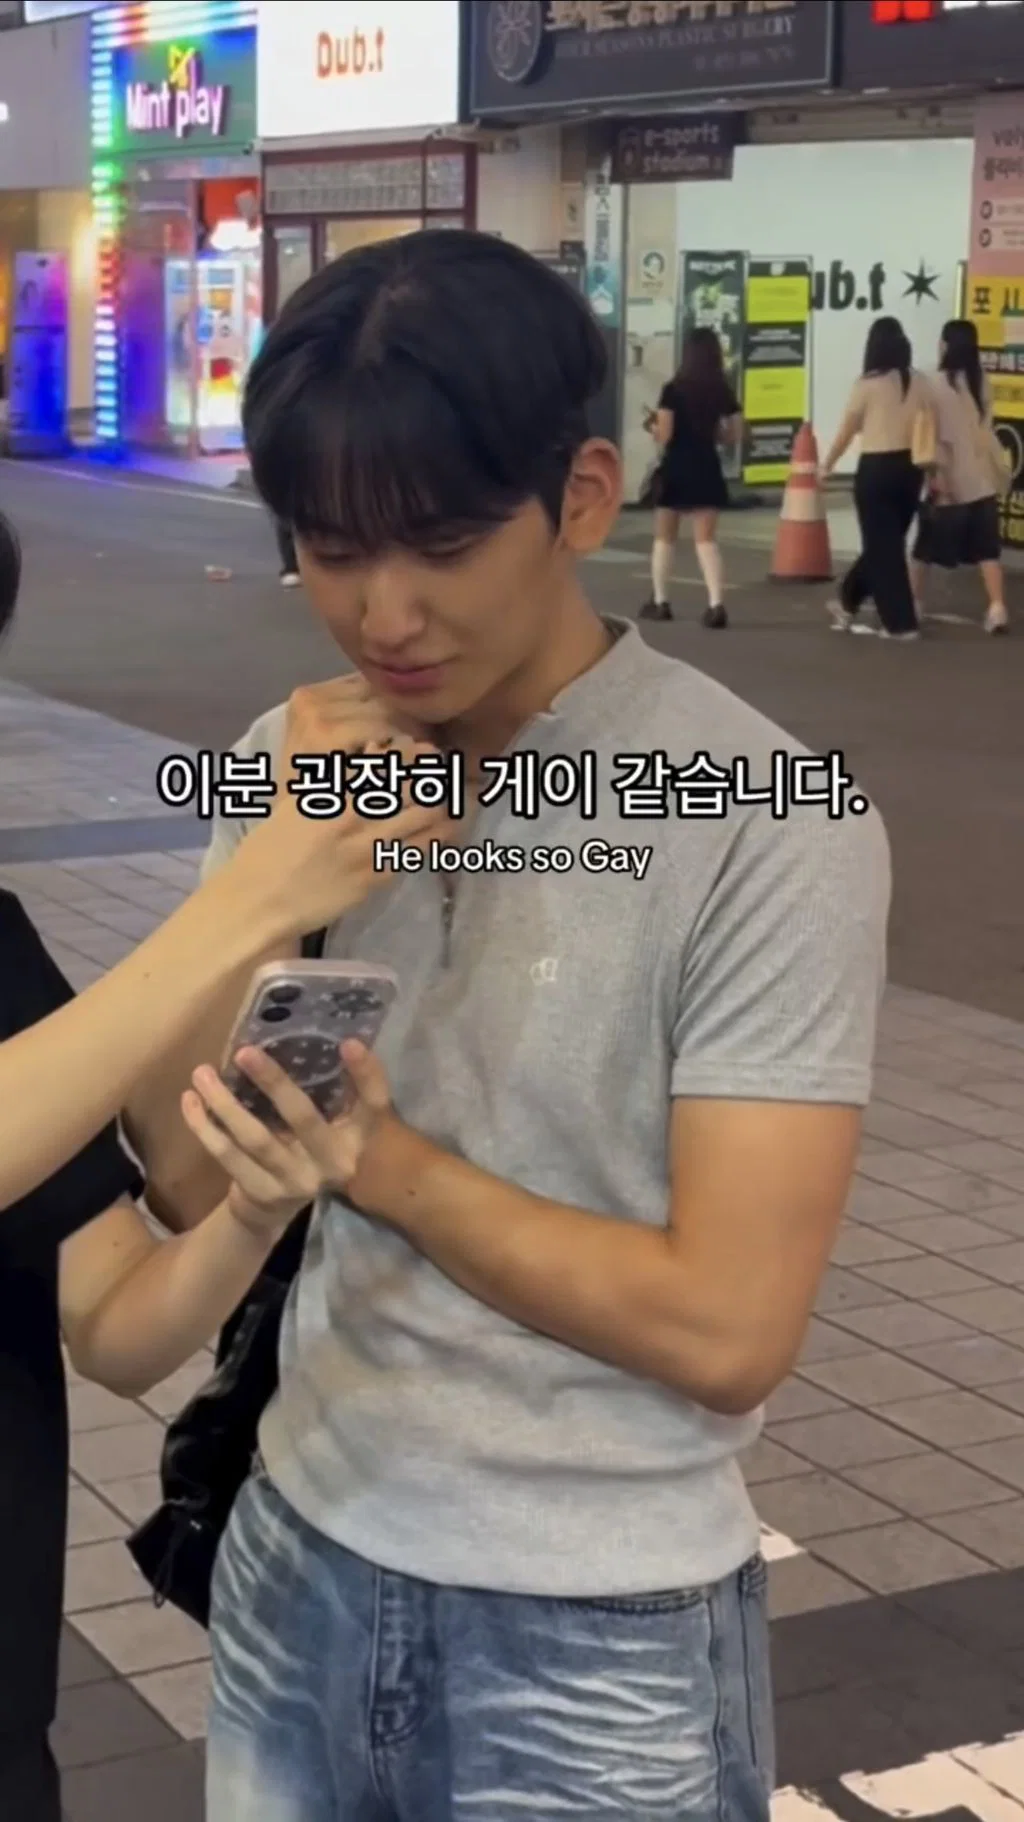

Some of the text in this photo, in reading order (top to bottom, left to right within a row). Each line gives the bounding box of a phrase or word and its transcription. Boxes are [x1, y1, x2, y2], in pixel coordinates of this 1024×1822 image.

[317, 26, 384, 79] Dub.t
[127, 56, 223, 138] Mint play
[644, 122, 719, 147] e-sports
[643, 149, 710, 174] stadium
[811, 259, 886, 311] ub.t
